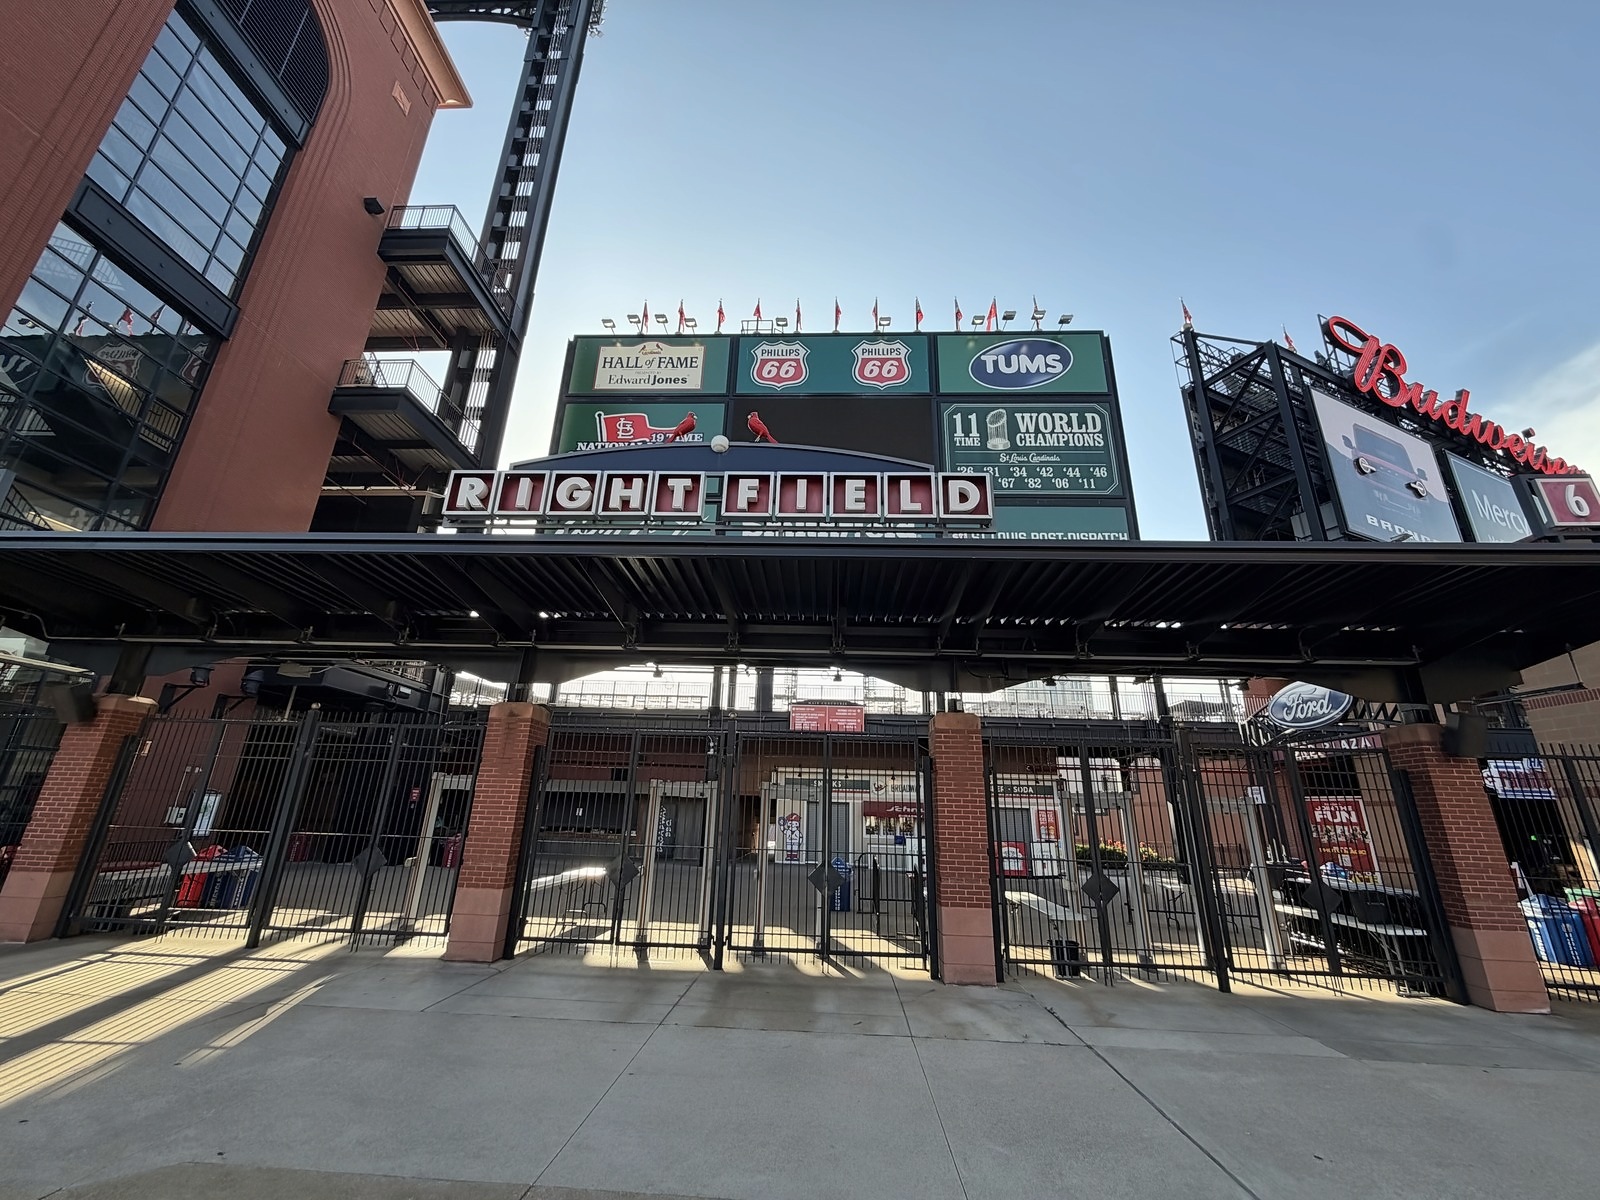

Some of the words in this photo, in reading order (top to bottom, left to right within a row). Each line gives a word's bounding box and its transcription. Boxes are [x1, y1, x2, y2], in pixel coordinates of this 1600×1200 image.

[761, 347, 801, 357] PHILLIPS
[861, 347, 902, 356] PHILLIPS
[601, 356, 643, 369] HALL
[644, 357, 656, 369] of
[657, 356, 699, 369] FAME
[863, 360, 899, 378] 66
[980, 353, 1063, 375] TUMS
[761, 361, 798, 379] 66
[608, 374, 651, 385] Edward
[651, 374, 688, 386] Jones
[953, 412, 980, 437] 11
[1014, 412, 1102, 433] WORLD
[650, 433, 665, 443] 19
[954, 437, 981, 447] TIME
[1016, 433, 1105, 447] CHAMPIONS
[576, 442, 642, 451] NATION
[1029, 452, 1061, 463] Cardinals
[1010, 467, 1028, 477] '34
[1036, 467, 1054, 477] '42
[1063, 467, 1081, 477] '44
[1090, 467, 1108, 477] '46
[998, 478, 1016, 488] '67
[1025, 478, 1042, 488] '82
[1052, 478, 1069, 488] '06
[1079, 479, 1096, 488] '11
[456, 476, 693, 512] RIGHT
[736, 478, 981, 513] FIELD
[1564, 484, 1590, 517] 6
[1365, 513, 1440, 542] BRONC
[1283, 688, 1333, 721] Ford
[1012, 786, 1034, 794] SODA
[1314, 810, 1358, 823] FUN
